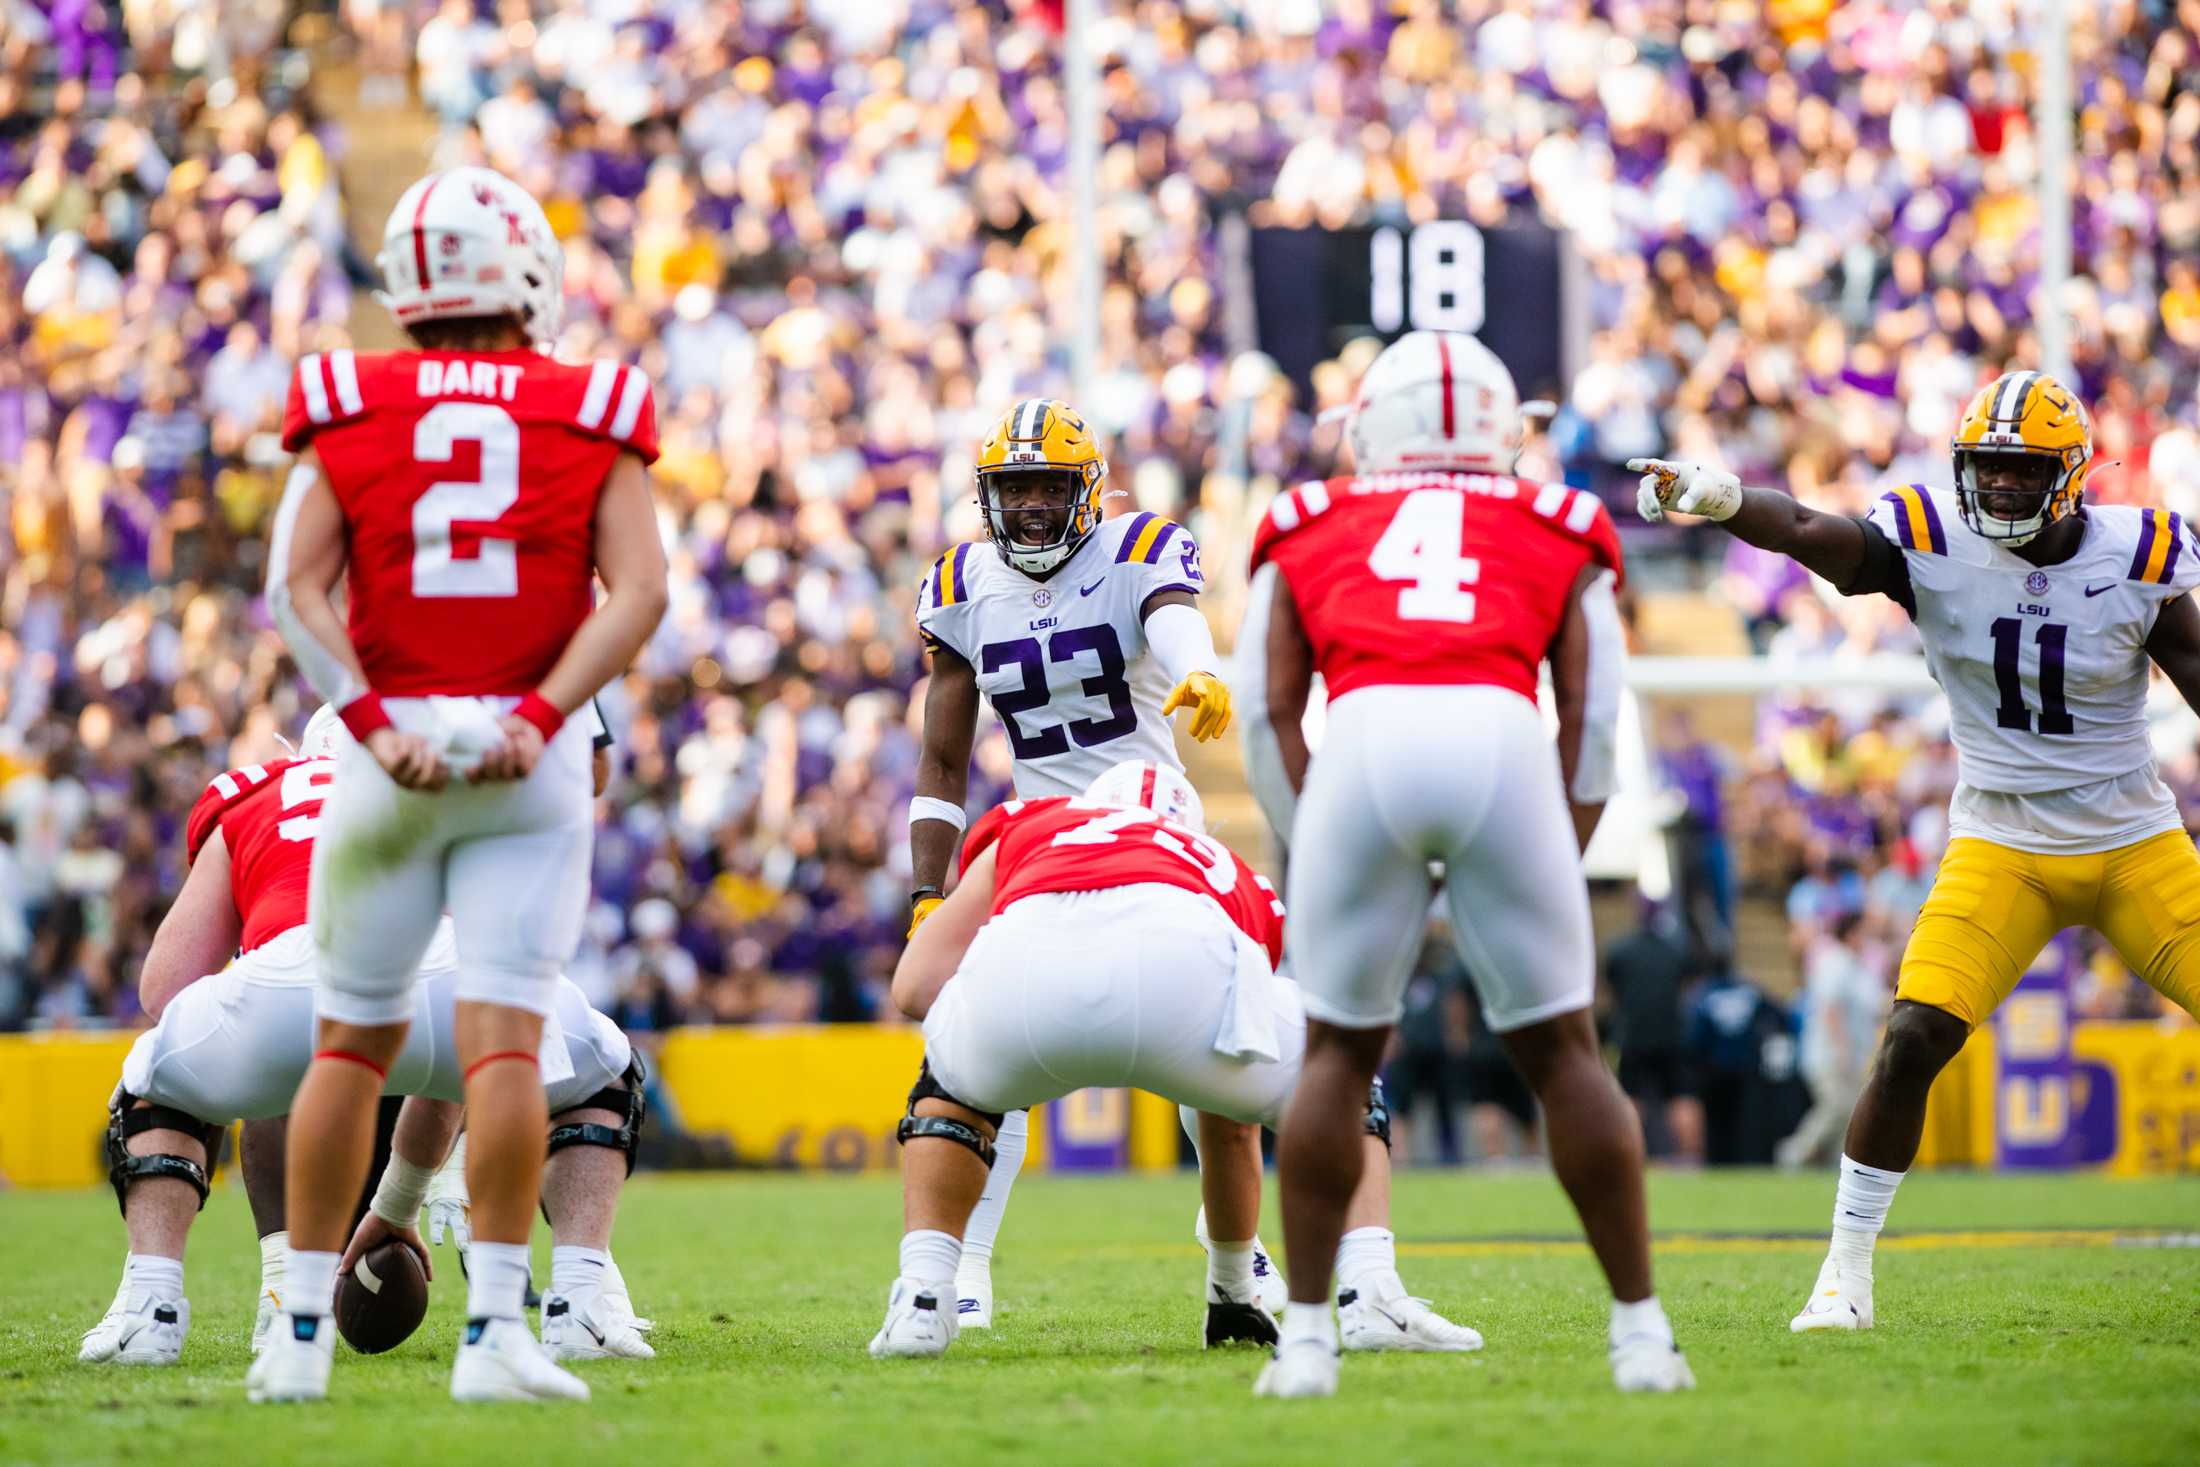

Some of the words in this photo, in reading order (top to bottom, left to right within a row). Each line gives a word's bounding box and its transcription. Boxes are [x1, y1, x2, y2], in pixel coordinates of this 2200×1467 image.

[1370, 220, 1486, 334] 18
[416, 360, 523, 401] DART
[1012, 453, 1036, 463] LSU
[411, 401, 521, 598] 2
[1181, 540, 1205, 582] 2
[1367, 487, 1481, 625] 4
[1029, 616, 1058, 631] LSU
[1033, 590, 1051, 607] SEC
[2017, 602, 2051, 617] LSU
[981, 622, 1138, 760] 23
[1990, 617, 2074, 734] 11
[1051, 796, 1238, 895] 73
